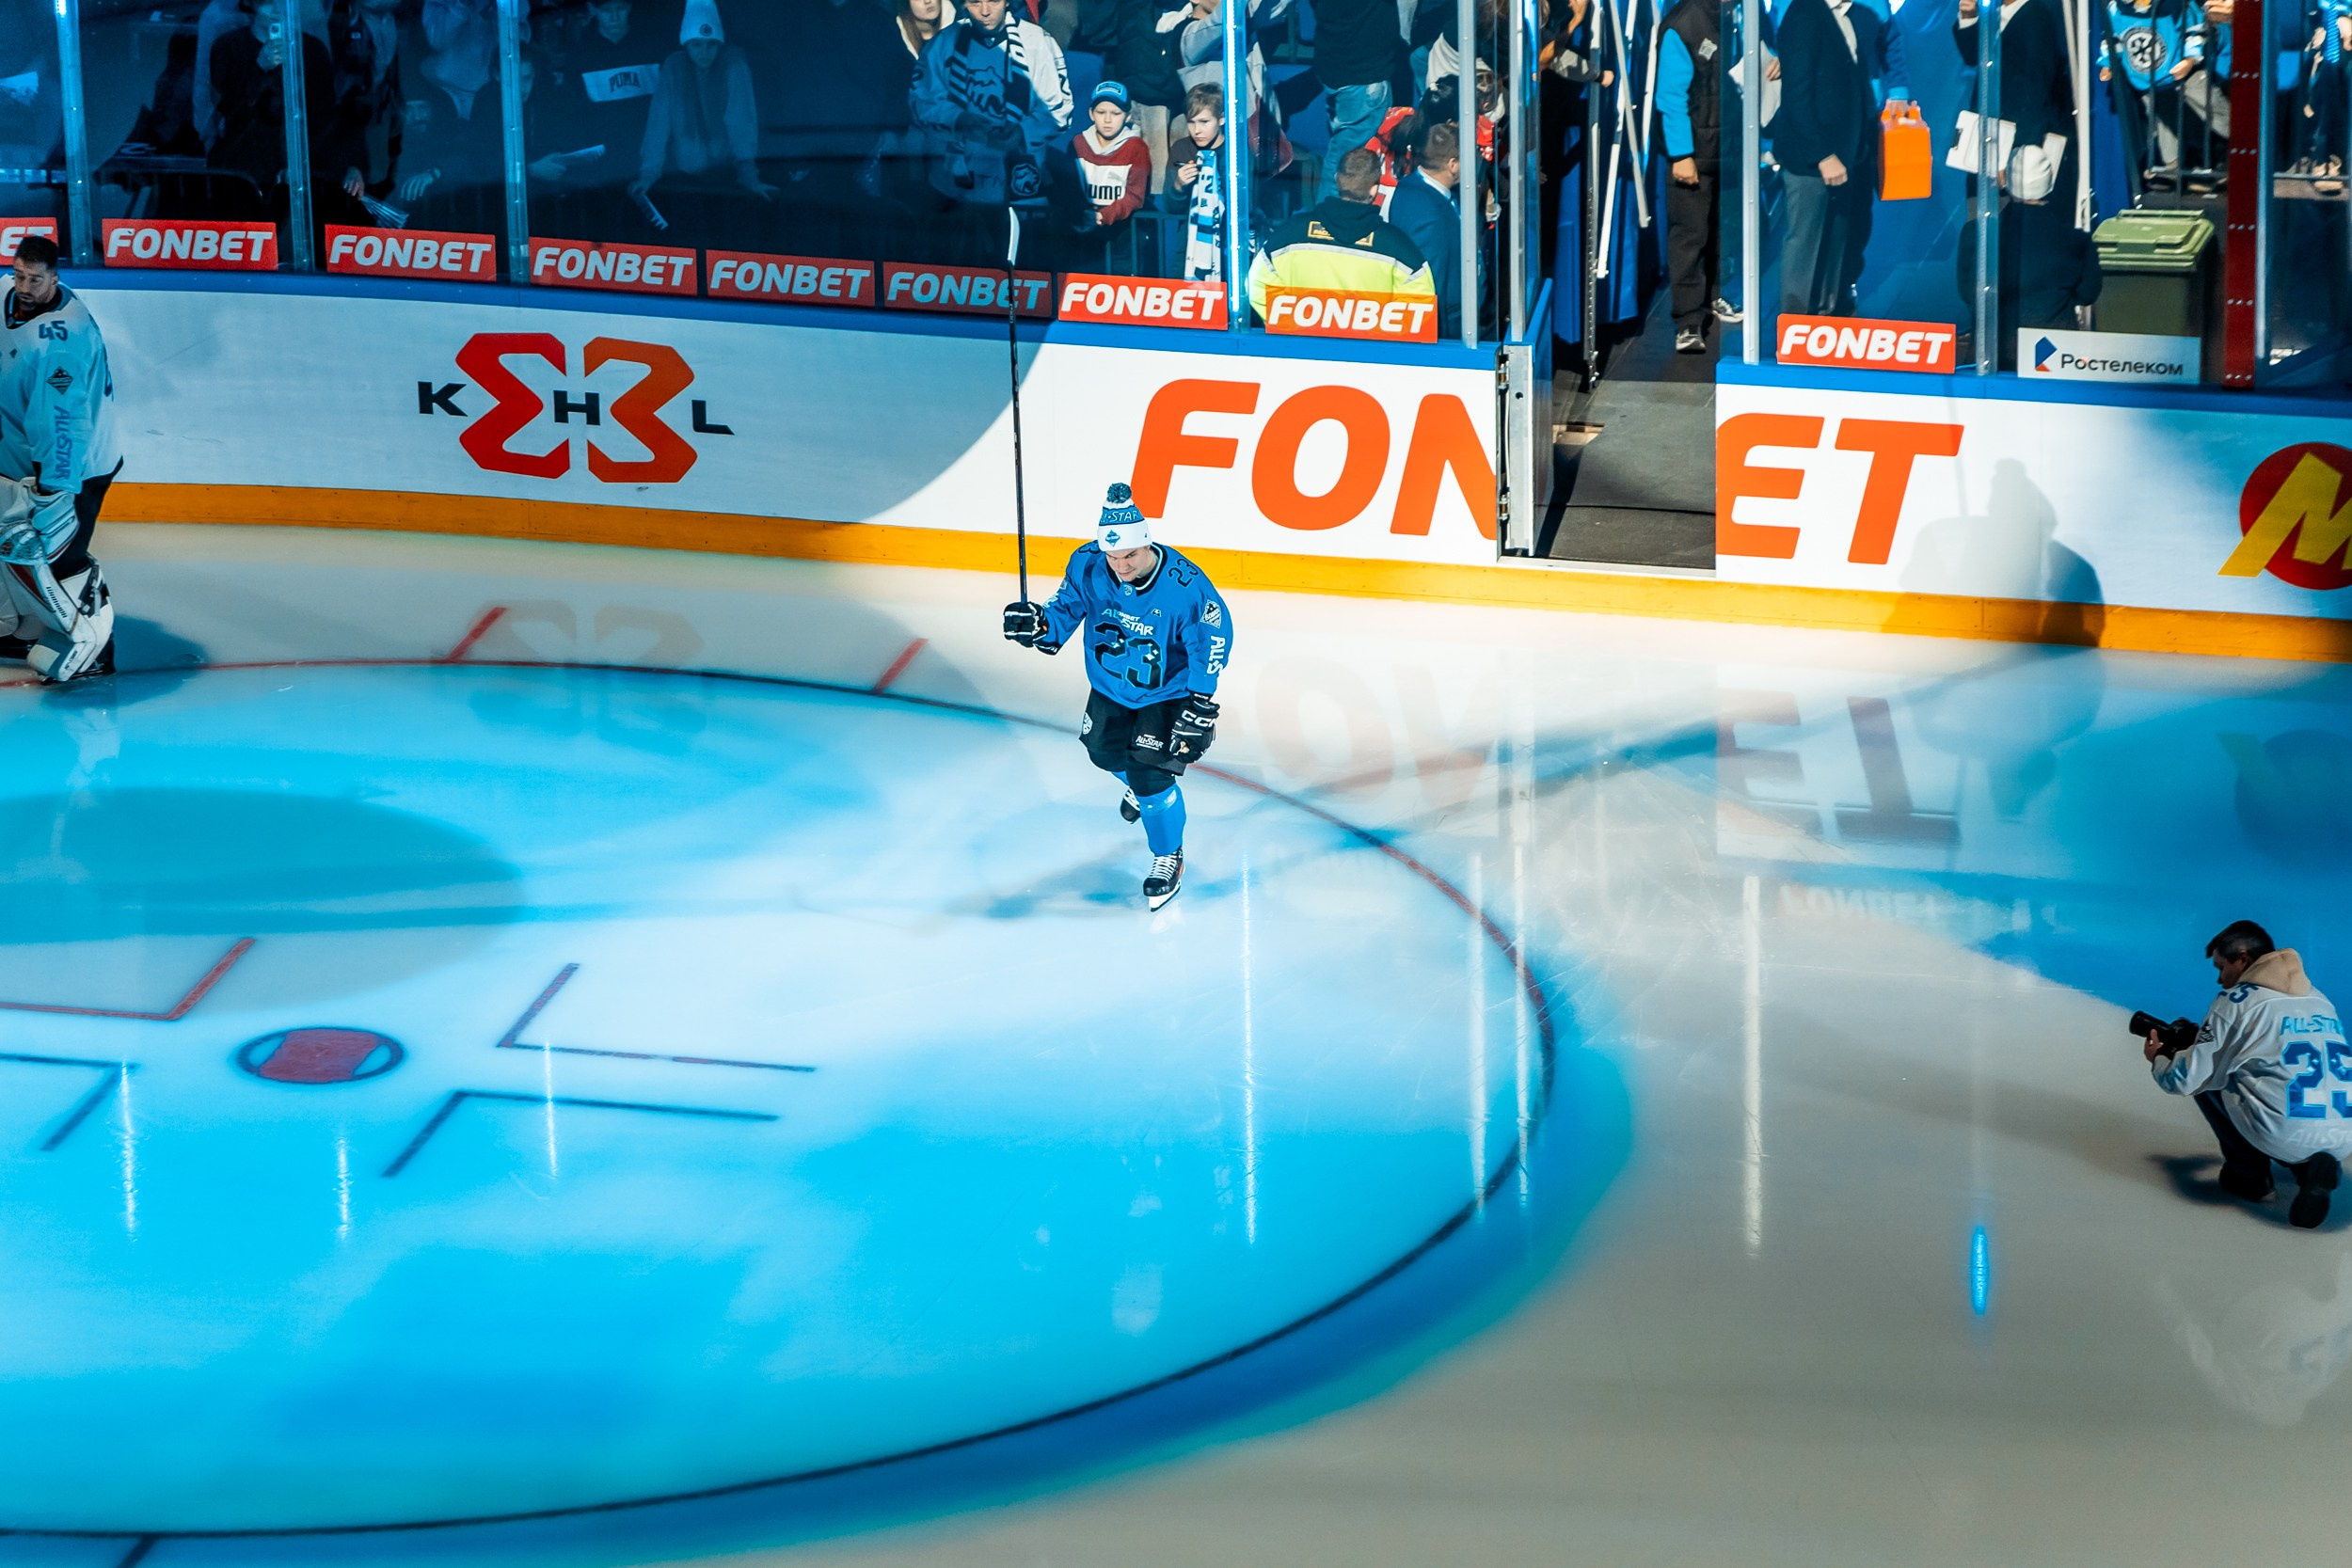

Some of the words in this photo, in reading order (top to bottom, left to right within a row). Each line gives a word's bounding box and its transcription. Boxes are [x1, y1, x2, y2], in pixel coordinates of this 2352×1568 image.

[609, 71, 640, 92] PUMA
[1088, 184, 1122, 200] UMA
[106, 228, 274, 261] FONBET
[329, 234, 492, 273] FONBET
[532, 247, 694, 286] FONBET
[710, 261, 870, 298] FONBET
[887, 272, 1048, 310] FONBET
[1061, 282, 1224, 321] FONBET
[39, 320, 69, 341] 45
[1268, 295, 1435, 333] FONBET
[1780, 325, 1953, 364] FONBET
[2061, 354, 2184, 375] Ростелеком
[1168, 558, 1200, 588] 23
[1092, 621, 1164, 691] 23
[2281, 1040, 2352, 1120] 25
